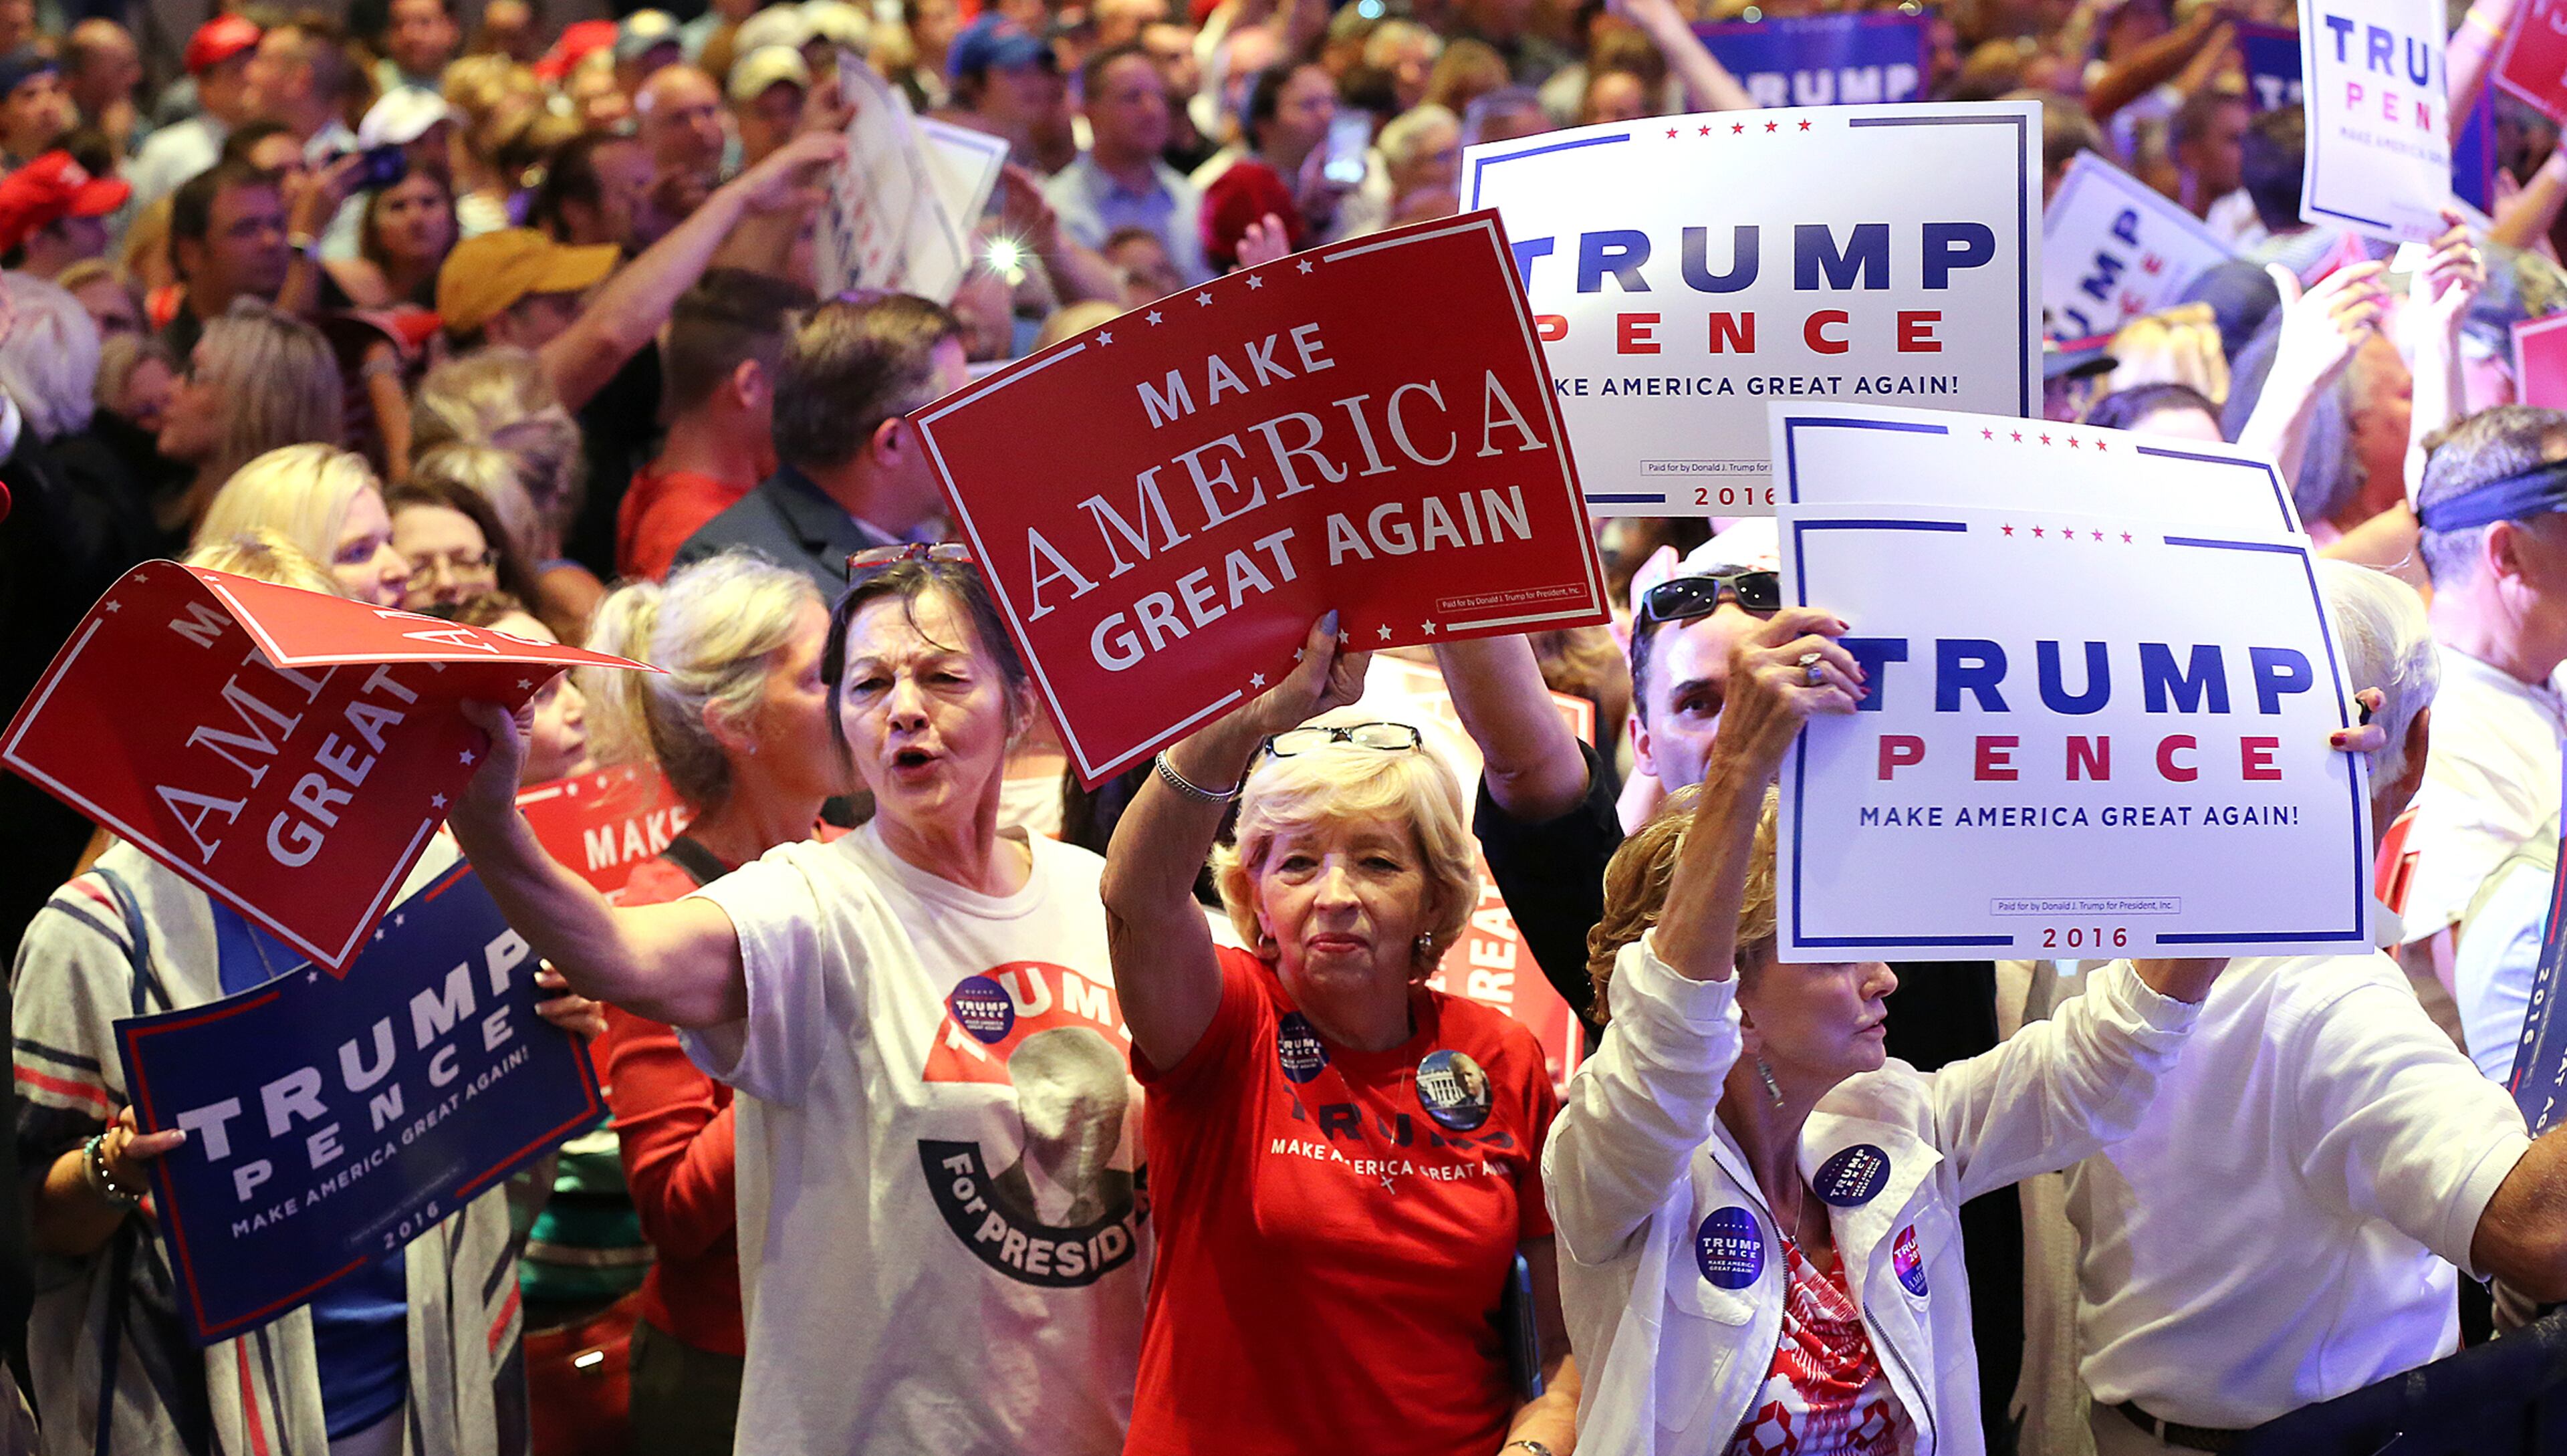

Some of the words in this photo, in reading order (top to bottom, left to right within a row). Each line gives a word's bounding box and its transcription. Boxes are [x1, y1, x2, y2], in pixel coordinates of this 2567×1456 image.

[2325, 13, 2429, 87] TRU
[1746, 64, 1919, 107] RUMP
[2346, 81, 2431, 132] PEN
[1136, 322, 1336, 430] MAKE
[1554, 378, 1589, 396] KE
[1600, 376, 1733, 396] AMERICA
[1746, 376, 1843, 396] GREAT
[1854, 375, 1961, 395] AGAIN!
[1648, 463, 1666, 471] Paid
[1667, 463, 1678, 471] for
[1680, 463, 1690, 473] by
[1692, 463, 1720, 471] Donald
[1729, 463, 1755, 474] Trump
[1757, 463, 1768, 471] for
[1028, 369, 1548, 623] AMERICA
[1694, 487, 1775, 505] 2016
[1090, 527, 1298, 673] GREAT
[1326, 485, 1533, 566] AGAIN
[1442, 600, 1457, 609] Paid
[1457, 598, 1467, 608] for
[1475, 596, 1499, 605] Donald
[1505, 593, 1525, 602] Trump
[1836, 638, 2316, 715] TRUMP
[267, 662, 419, 868] GREAT
[1877, 734, 2283, 782] PENCE
[583, 805, 689, 872] MAKE
[1859, 806, 1943, 827] MAKE
[1955, 806, 2090, 827] AMERICA
[2100, 806, 2192, 827] GREAT
[2203, 805, 2300, 826] AGAIN!
[1998, 902, 2015, 911] Paid
[2018, 902, 2029, 910] for
[2030, 902, 2040, 912] by
[2042, 902, 2071, 910] Donald
[2079, 902, 2105, 911] Trump
[2106, 902, 2118, 910] for
[2119, 902, 2157, 911] President,
[1467, 874, 1518, 1017] REAT
[2042, 927, 2127, 948] 2016
[944, 967, 1133, 1063] TUM
[2523, 967, 2550, 1045] 2016
[176, 927, 532, 1162] TRUMP
[233, 1005, 514, 1203] PENCE
[231, 1197, 298, 1239] MAKE
[305, 1141, 397, 1206] AMERICA
[401, 1092, 460, 1145] GREAT
[465, 1044, 529, 1101] AGAIN!
[1271, 1138, 1325, 1161] MAKE
[1330, 1148, 1414, 1176] AERICA
[1830, 1148, 1864, 1197] TRUMP
[383, 1200, 440, 1249] 2016
[973, 1214, 1128, 1278] PRESID
[1703, 1237, 1761, 1251] TRUMP
[1894, 1238, 1917, 1258] TRU
[1706, 1249, 1757, 1259] PENCE
